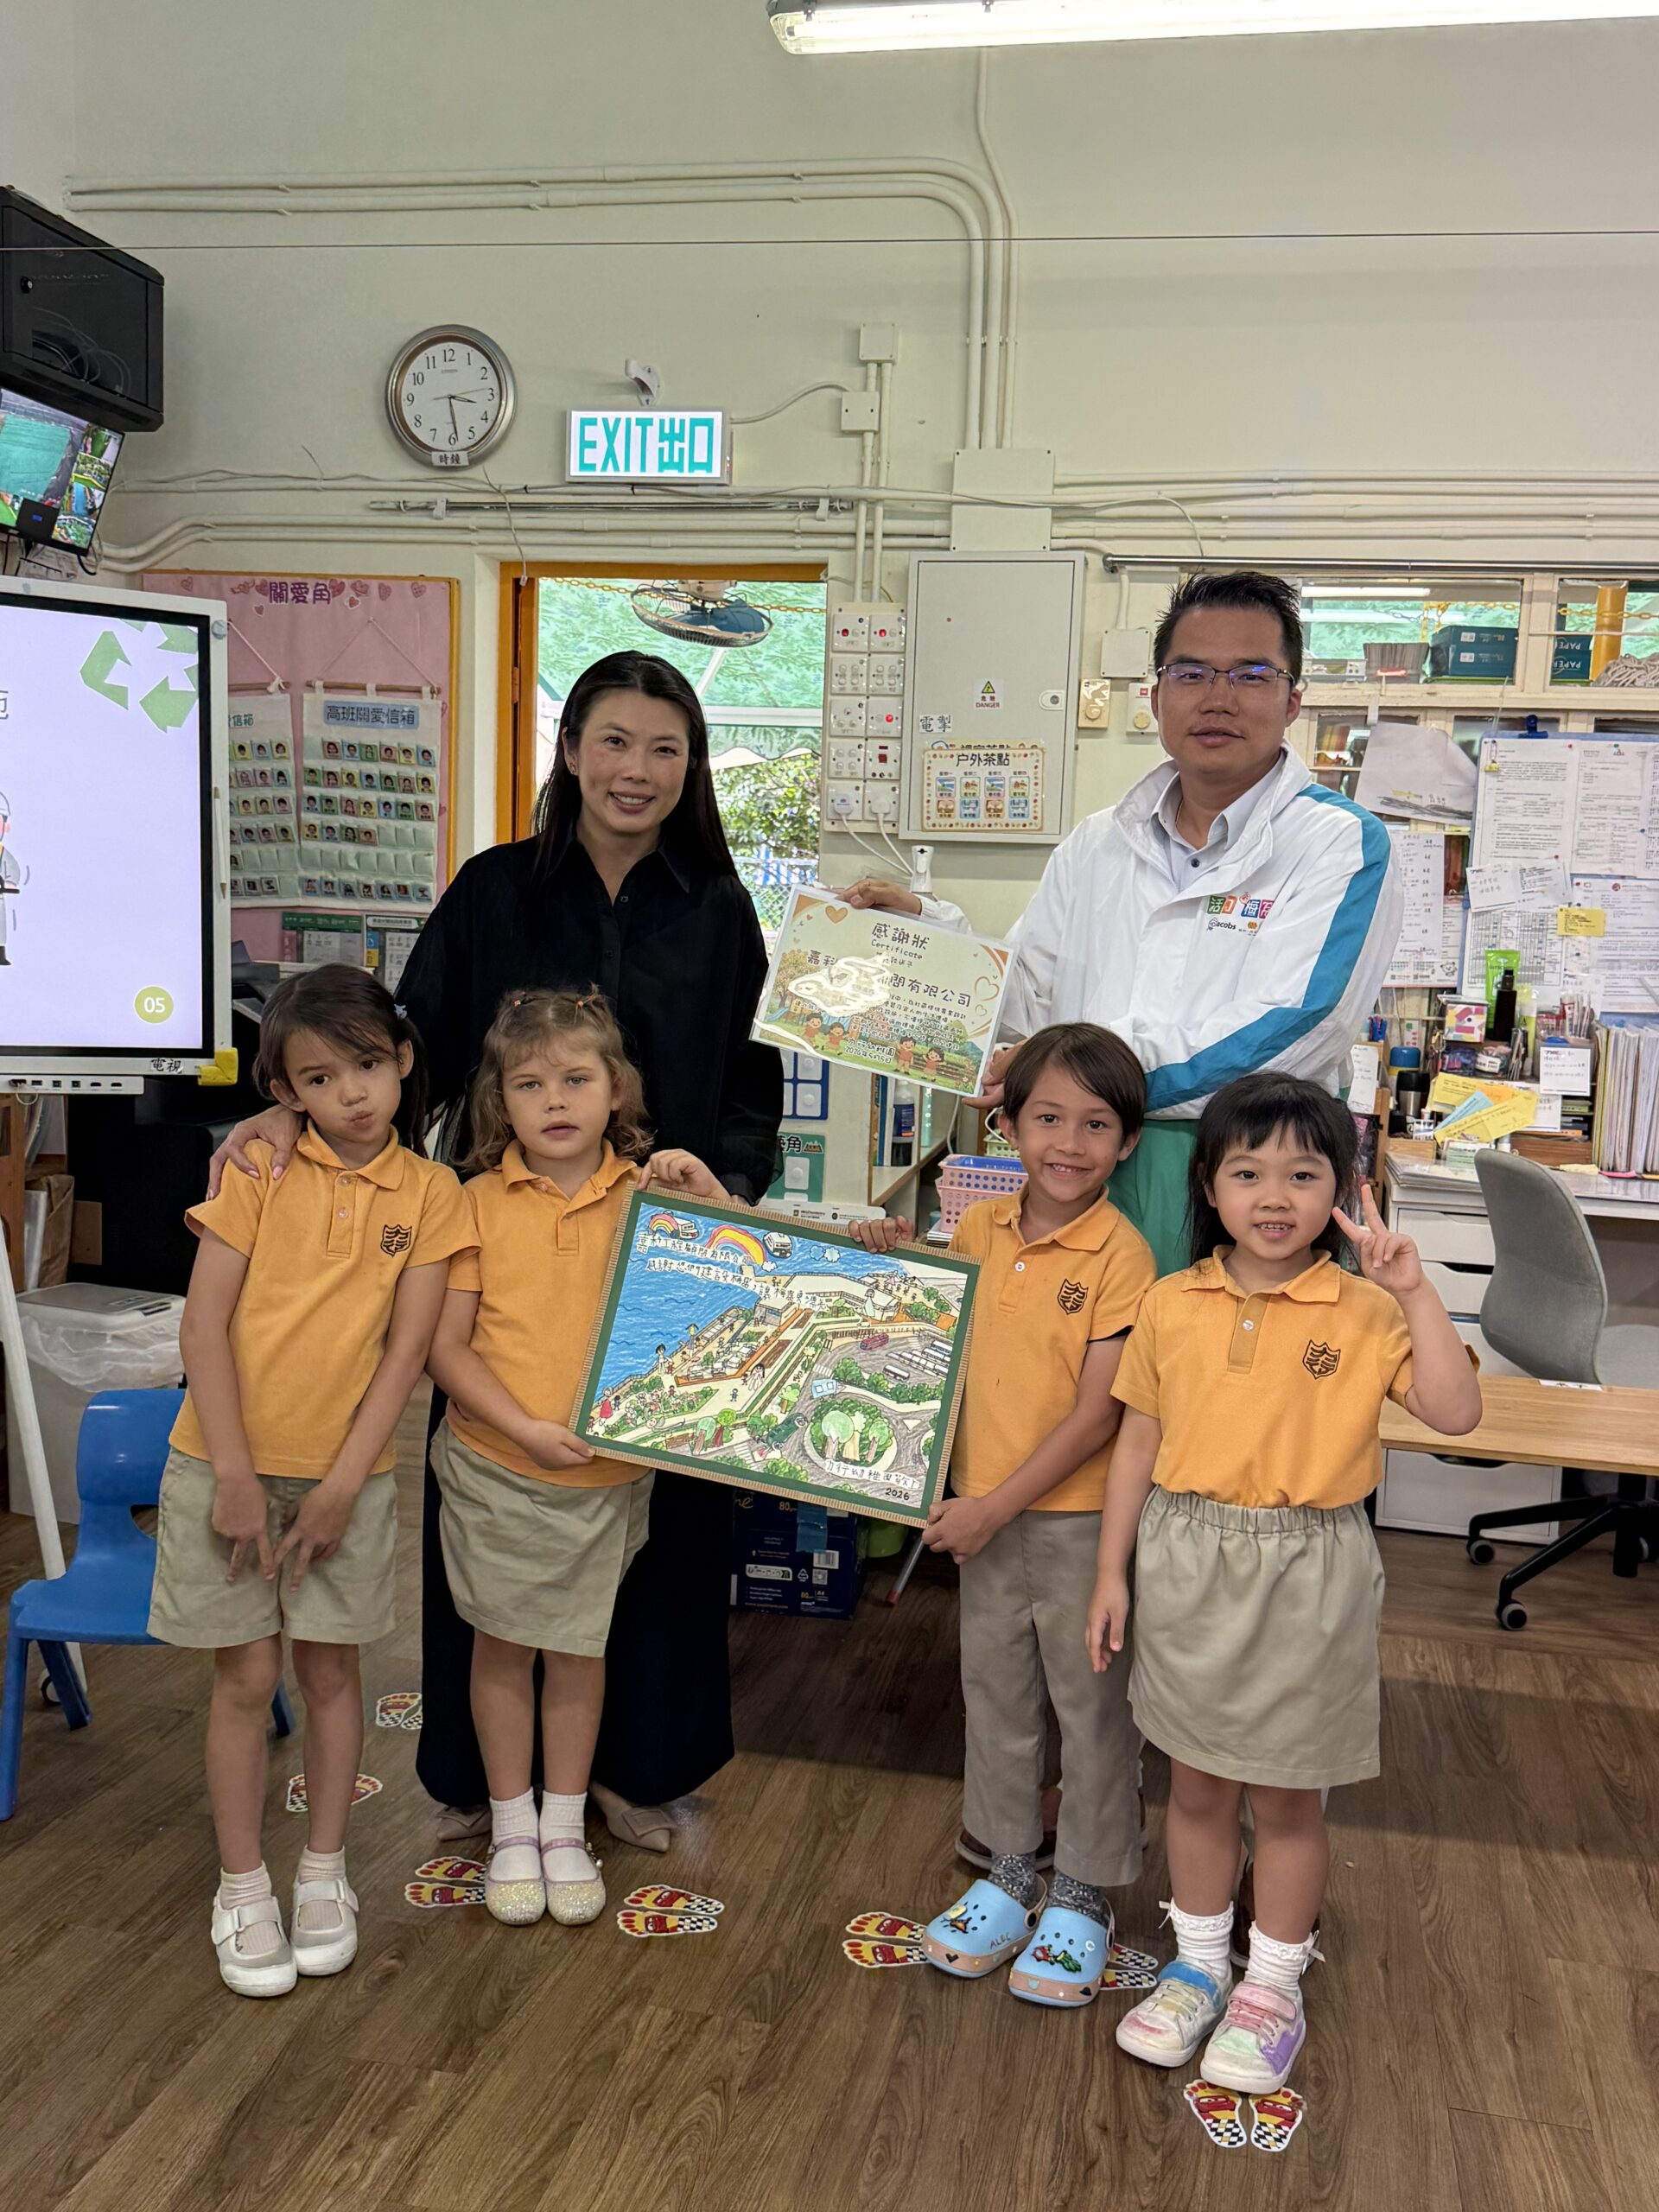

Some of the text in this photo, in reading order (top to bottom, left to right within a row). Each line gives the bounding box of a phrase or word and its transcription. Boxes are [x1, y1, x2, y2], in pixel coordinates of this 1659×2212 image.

[426, 355, 436, 369] 11
[443, 348, 455, 363] 12
[467, 352, 472, 365] 1
[412, 372, 424, 385] 10
[480, 366, 488, 380] 2
[406, 392, 415, 406] 9
[487, 387, 495, 401] 3
[414, 414, 423, 428] 8
[480, 410, 488, 423] 4
[430, 428, 437, 442] 7
[448, 432, 456, 446] 6
[467, 426, 475, 440] 5
[578, 417, 715, 474] EXIT 出口
[439, 454, 461, 464] 時鐘
[270, 582, 332, 605] 關愛角
[326, 705, 416, 726] 高班關愛信箱
[919, 715, 951, 733] 電掣
[871, 922, 930, 950] 感謝狀
[871, 938, 923, 960] Certificate
[143, 997, 165, 1013] 05
[150, 1058, 182, 1074] 電視
[885, 1487, 910, 1501] 2026
